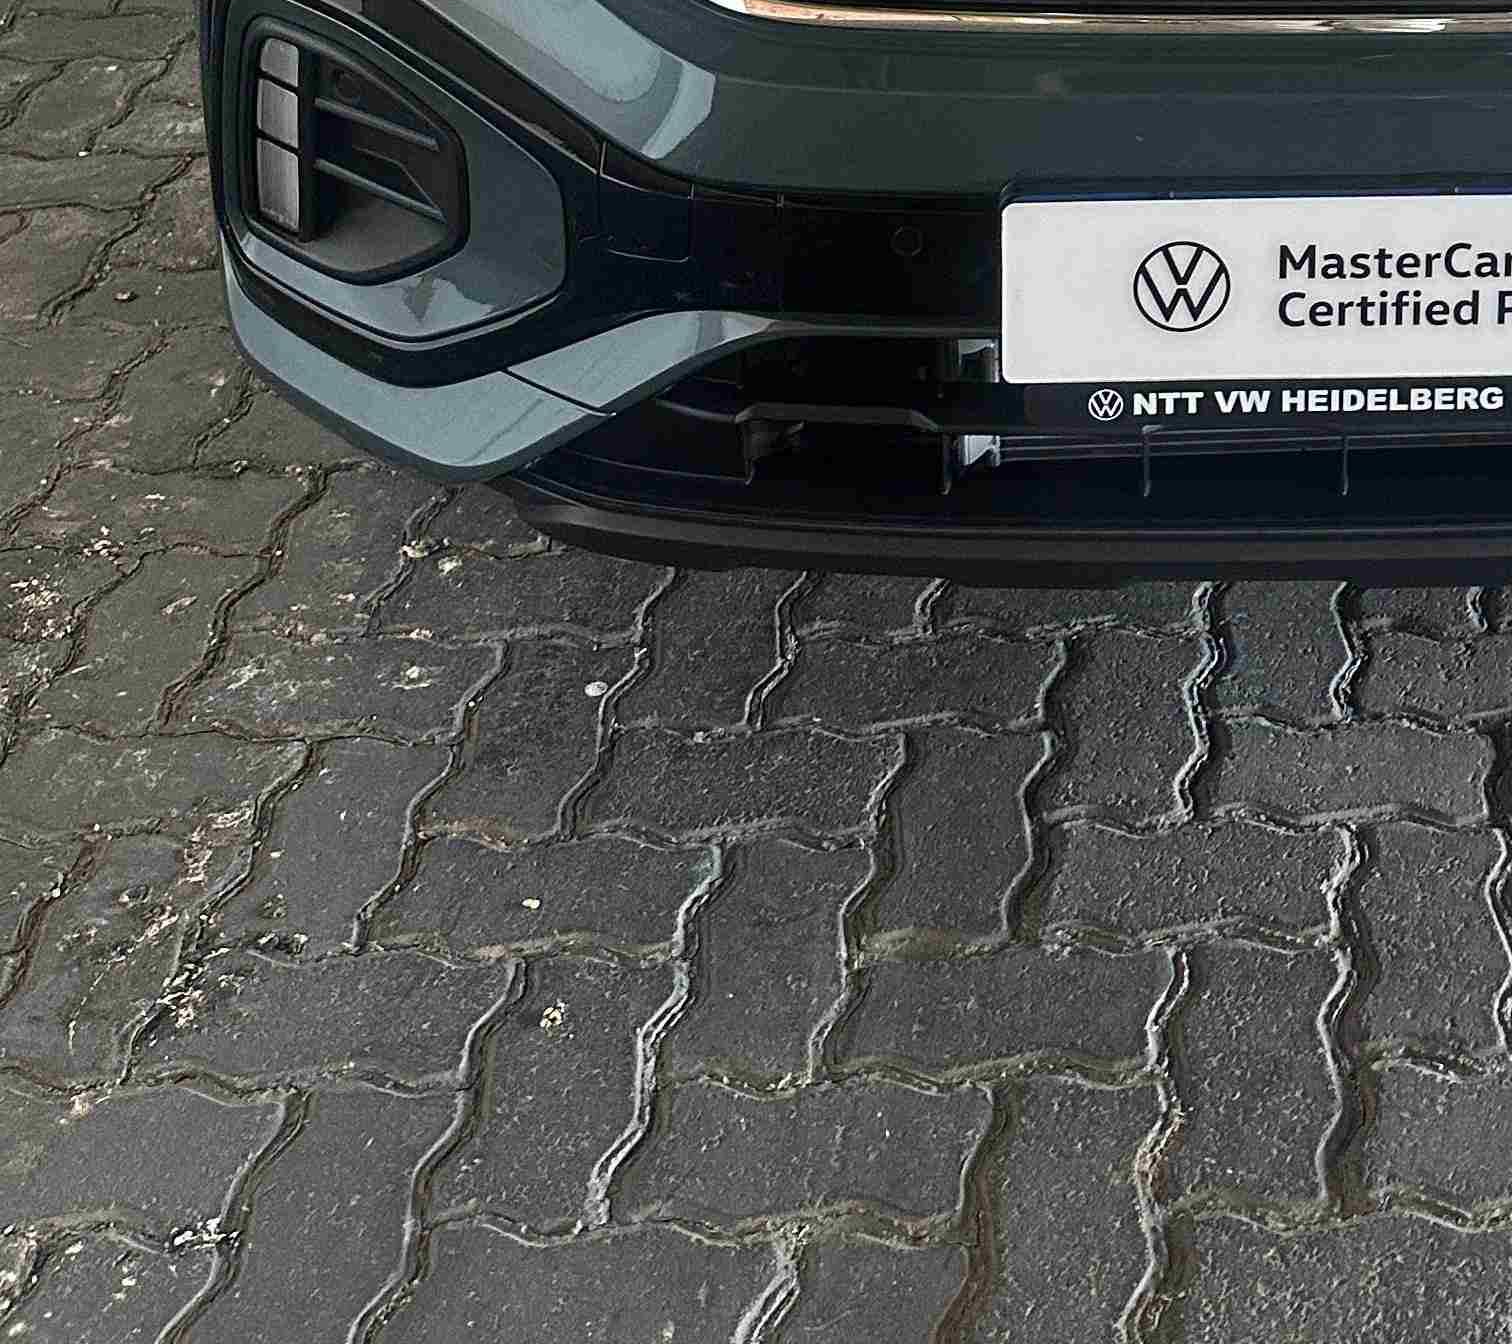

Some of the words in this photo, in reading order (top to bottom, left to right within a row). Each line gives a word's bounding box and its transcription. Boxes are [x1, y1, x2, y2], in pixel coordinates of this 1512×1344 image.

[1278, 288, 1481, 328] Certified
[1132, 391, 1205, 416] NTT
[1213, 390, 1272, 414] VW
[1280, 386, 1505, 413] HEIDELBERG
